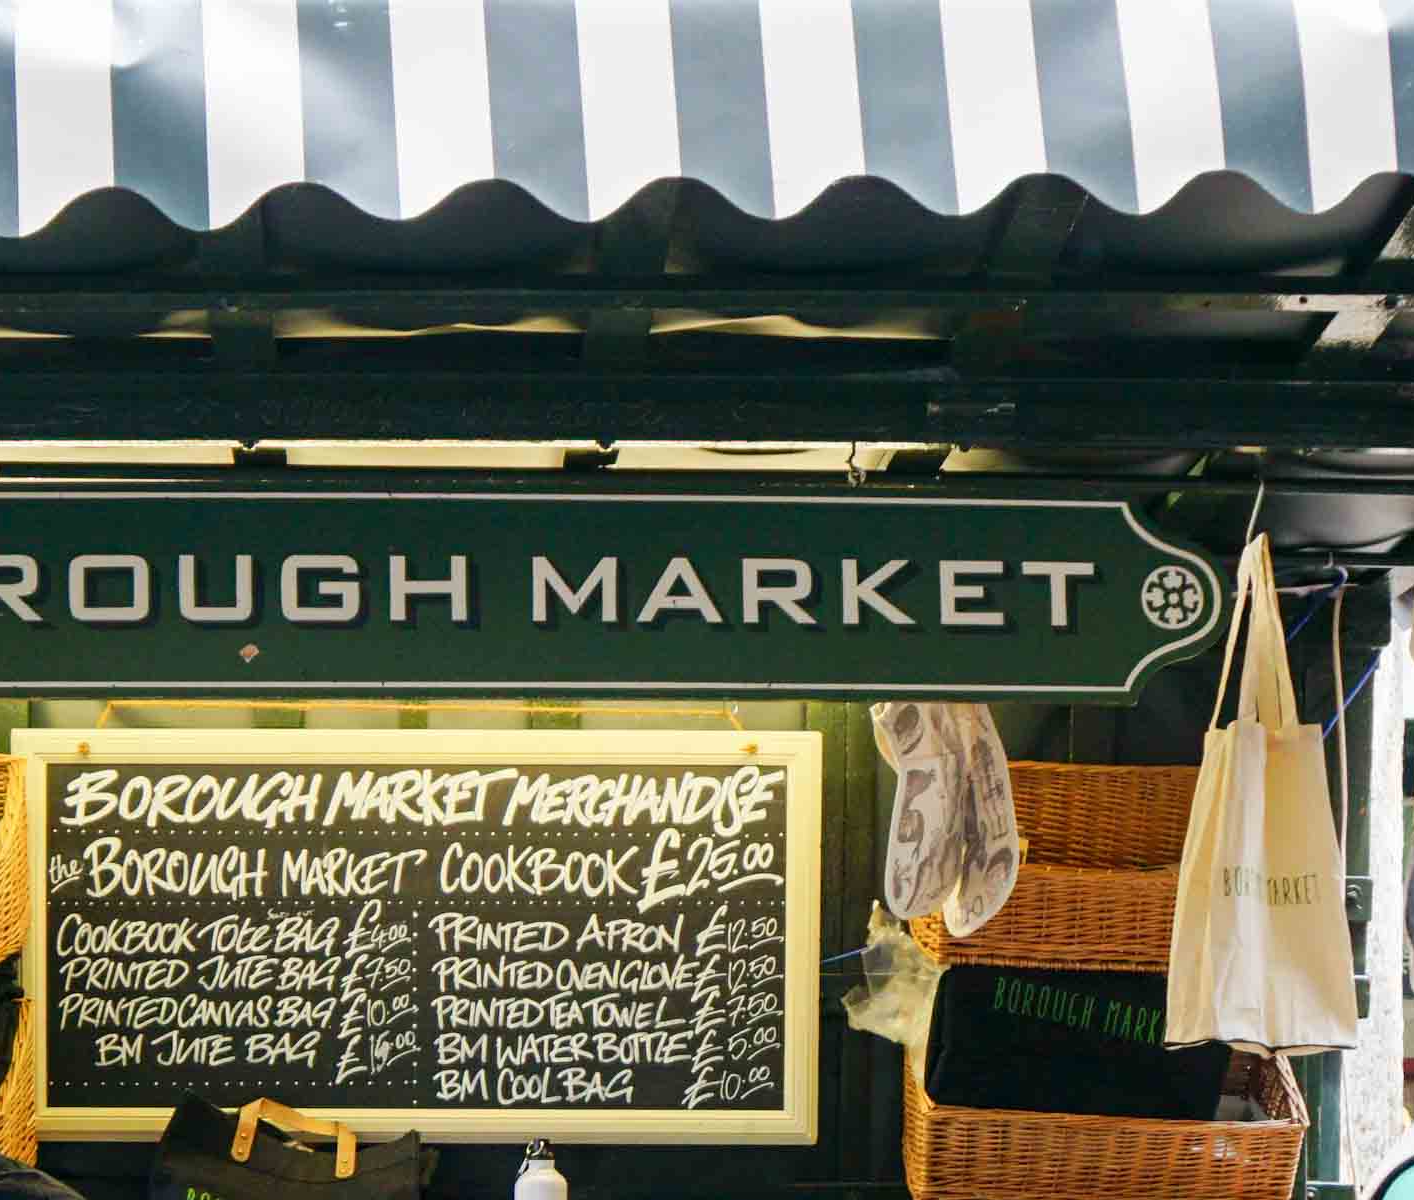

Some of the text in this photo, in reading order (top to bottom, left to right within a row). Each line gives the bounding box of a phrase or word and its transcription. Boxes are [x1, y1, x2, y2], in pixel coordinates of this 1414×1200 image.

[532, 555, 1095, 628] MARKET
[59, 766, 785, 836] BOROUGH MARKET MERCHANDISE
[49, 855, 83, 890] the
[83, 837, 268, 899] BOROUGH
[282, 848, 427, 897] MARKET
[440, 842, 641, 896] COOKBOOK
[57, 913, 197, 957] COOKBOOK
[275, 916, 341, 956] BAG
[429, 912, 570, 953] PRINTED
[576, 913, 685, 953] APRON
[59, 956, 190, 992] PRINTED
[198, 957, 278, 992] JUTE
[275, 958, 341, 993] BAG
[432, 955, 554, 993] PRINTED
[556, 959, 626, 993] OVEN
[621, 956, 700, 993] GLOVE
[59, 993, 177, 1030] PRINTED
[178, 998, 272, 1029] CANVAS
[430, 994, 545, 1029] PRINTED
[543, 990, 587, 1027] TEA
[583, 993, 685, 1028] TOWEL
[995, 976, 1168, 1047] BOROUGH MARK
[95, 1034, 144, 1068] BM
[151, 1034, 236, 1067] JUTE
[245, 1031, 321, 1069] BAG
[434, 1033, 487, 1066] BM
[496, 1034, 593, 1067] WATER
[592, 1031, 694, 1064] BOTTLE
[432, 1069, 487, 1101] BM
[497, 1067, 562, 1105] COOL
[558, 1069, 633, 1104] BAG
